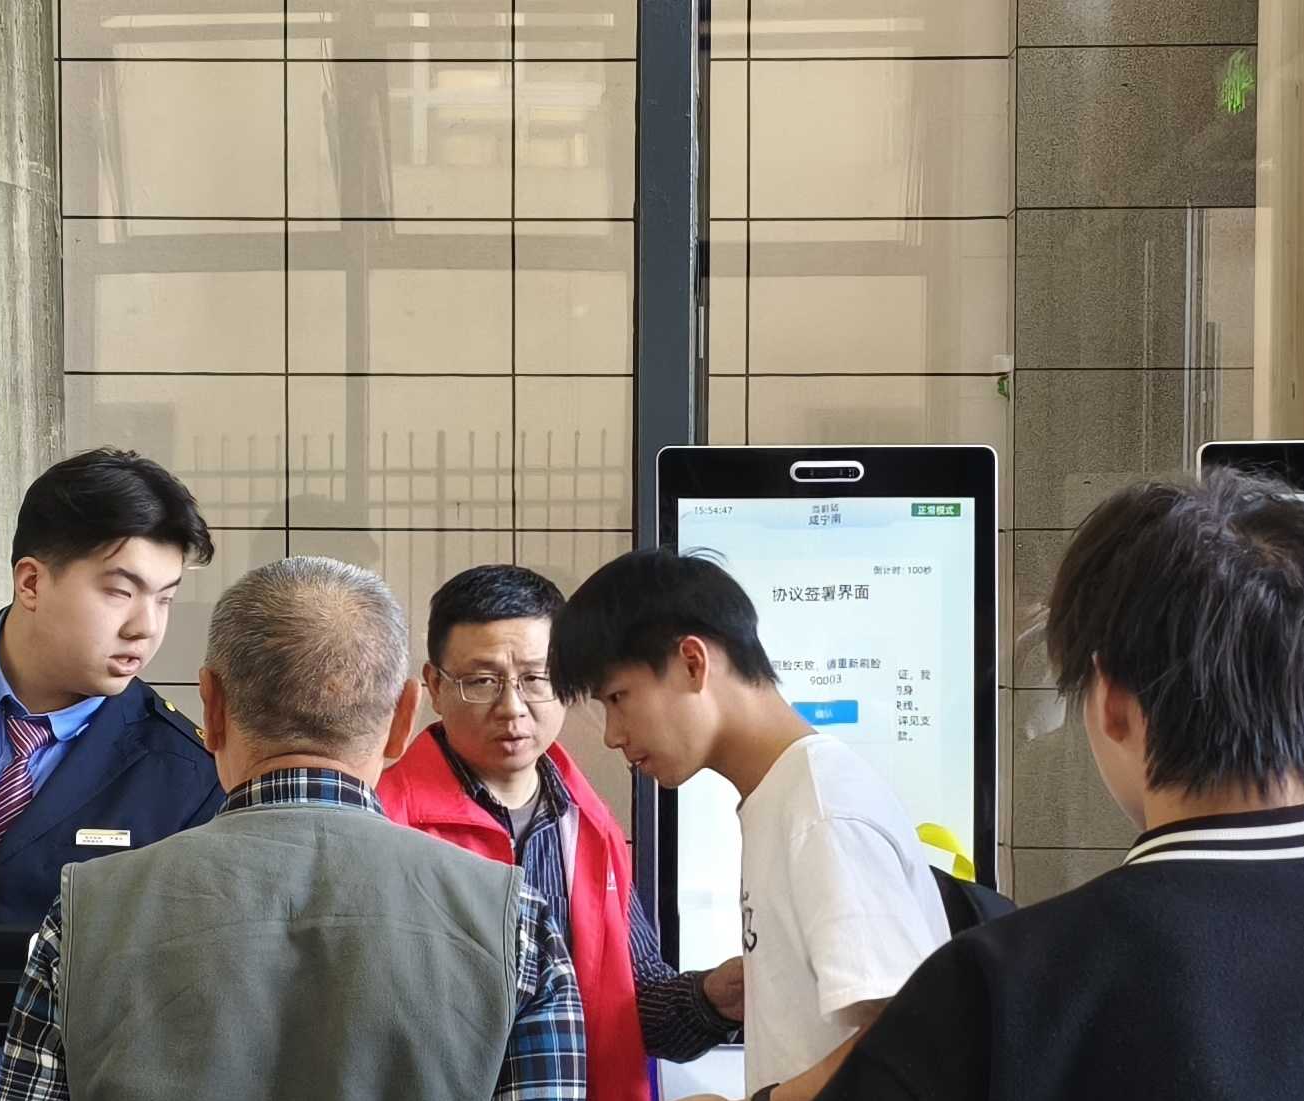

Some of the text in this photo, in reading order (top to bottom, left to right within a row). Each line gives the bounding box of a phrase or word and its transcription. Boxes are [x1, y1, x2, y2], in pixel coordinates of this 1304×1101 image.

[694, 506, 733, 515] 15:54:47
[772, 584, 870, 602] 协议签署界面
